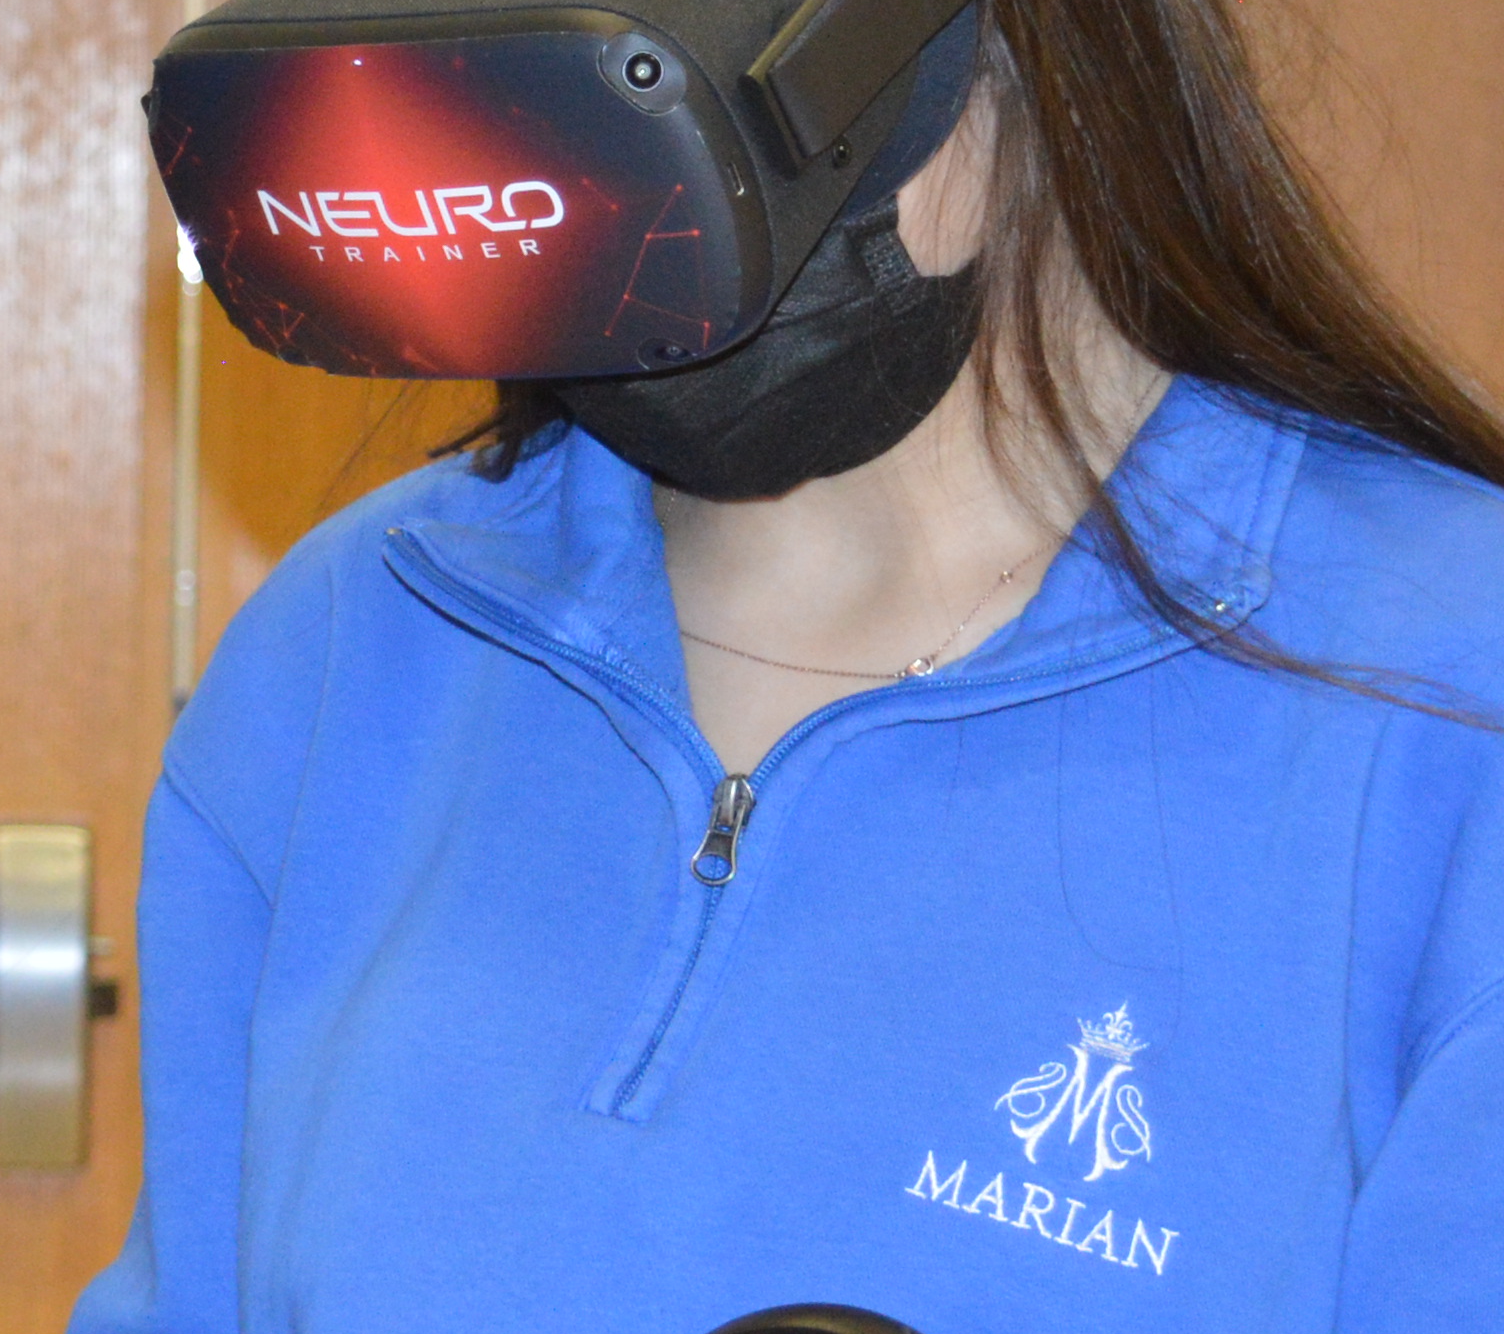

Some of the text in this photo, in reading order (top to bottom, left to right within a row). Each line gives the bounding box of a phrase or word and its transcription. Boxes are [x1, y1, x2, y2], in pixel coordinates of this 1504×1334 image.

[257, 180, 565, 237] NEURO
[308, 237, 541, 263] TRAINER
[904, 1149, 1180, 1276] MARIAN
